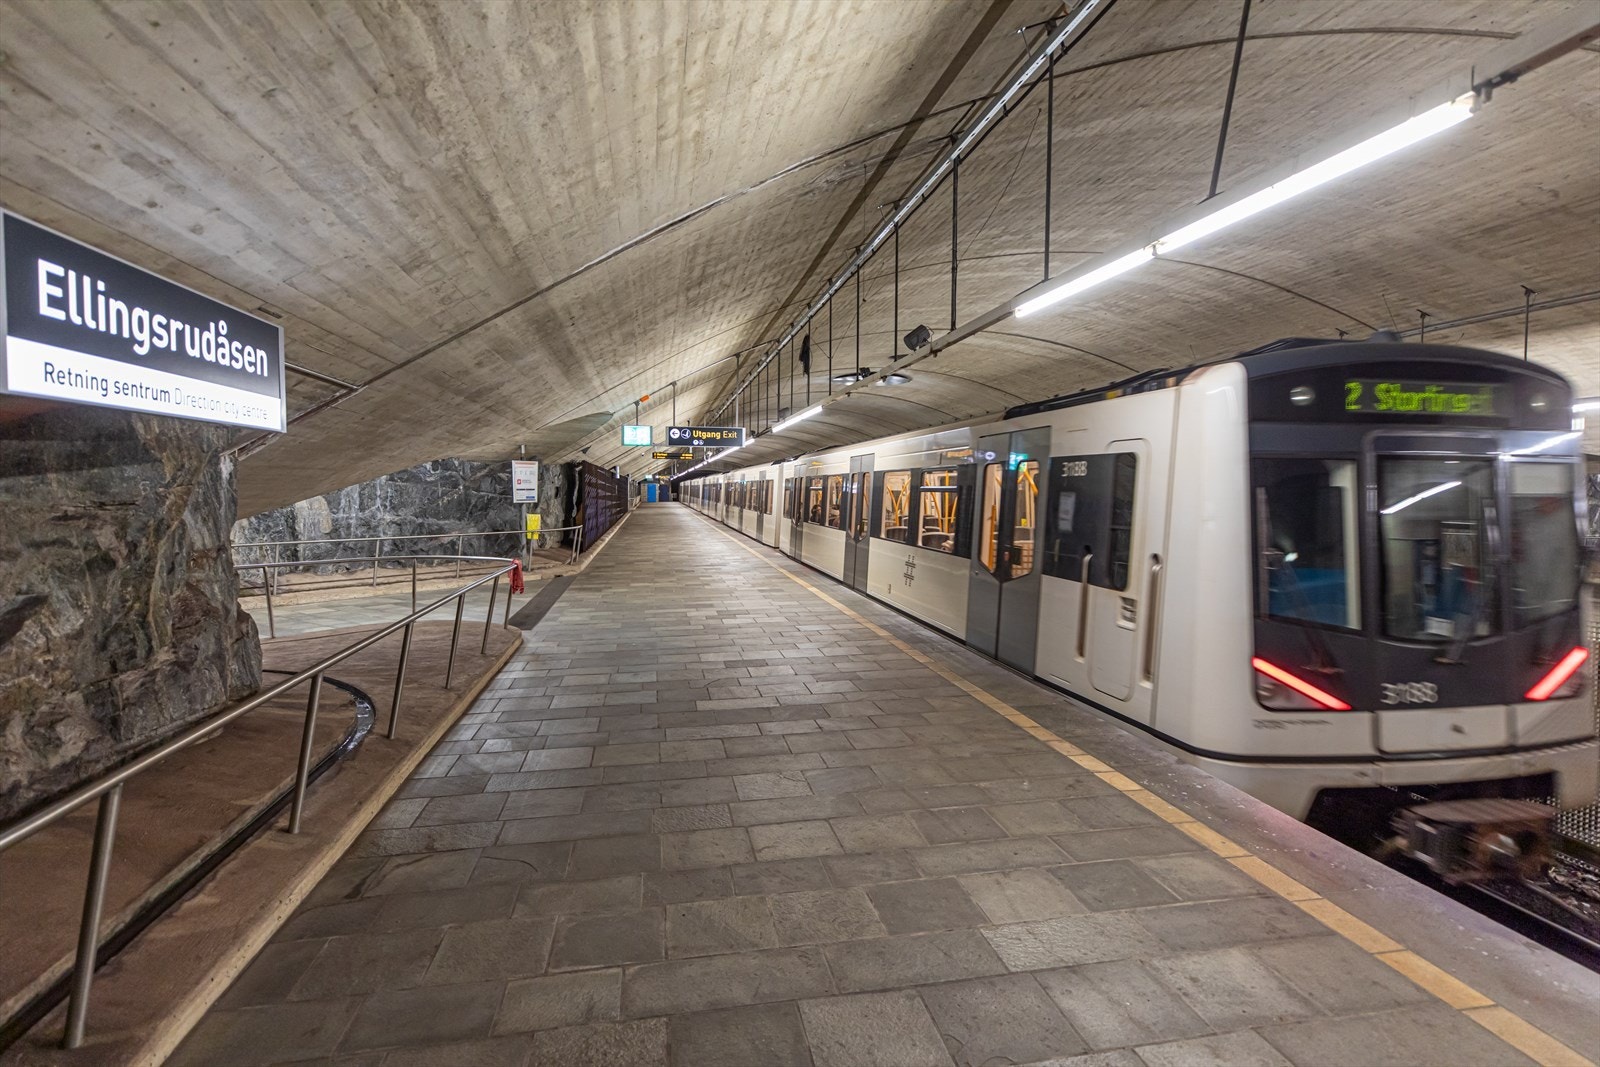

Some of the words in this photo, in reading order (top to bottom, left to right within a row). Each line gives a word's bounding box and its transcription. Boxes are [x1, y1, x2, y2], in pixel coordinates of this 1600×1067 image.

[37, 257, 269, 378] Ellingsrudåsen
[43, 361, 109, 397] Retning
[113, 380, 171, 404] sentrum
[174, 387, 222, 411] Direction
[224, 400, 240, 419] city
[241, 404, 268, 420] centre
[1344, 381, 1363, 411] 2
[692, 429, 721, 439] Utgang
[722, 430, 738, 439] Exit
